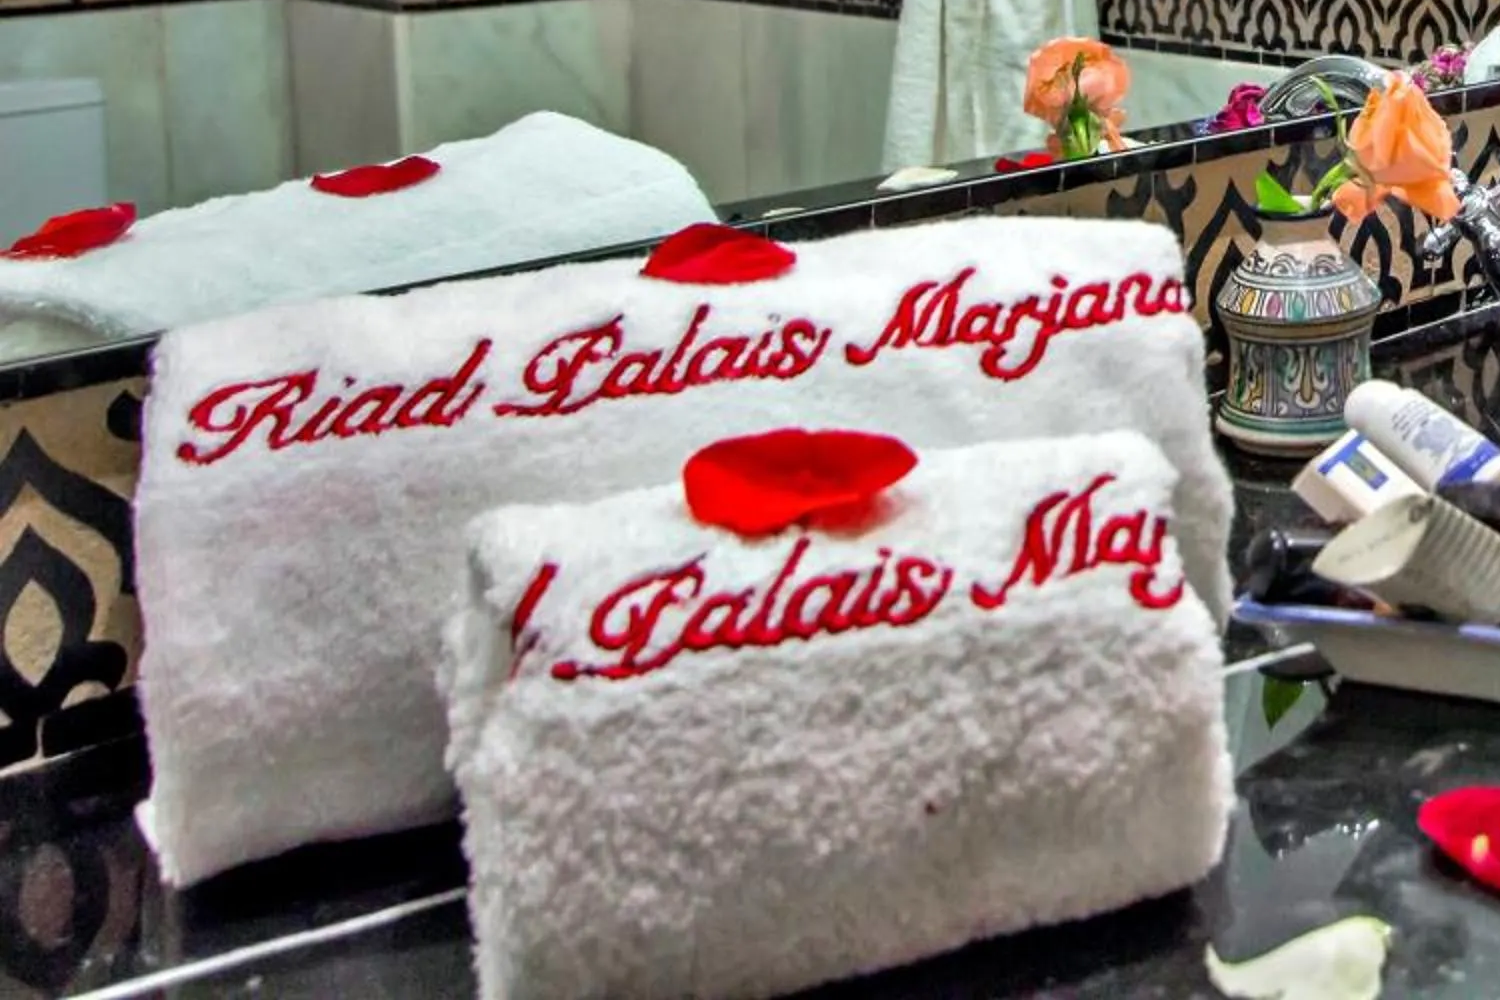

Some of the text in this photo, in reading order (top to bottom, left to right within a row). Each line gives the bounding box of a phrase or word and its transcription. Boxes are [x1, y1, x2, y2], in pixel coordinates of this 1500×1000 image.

[177, 337, 492, 465] Riad
[493, 303, 832, 416] Palais
[551, 539, 954, 680] Palais
